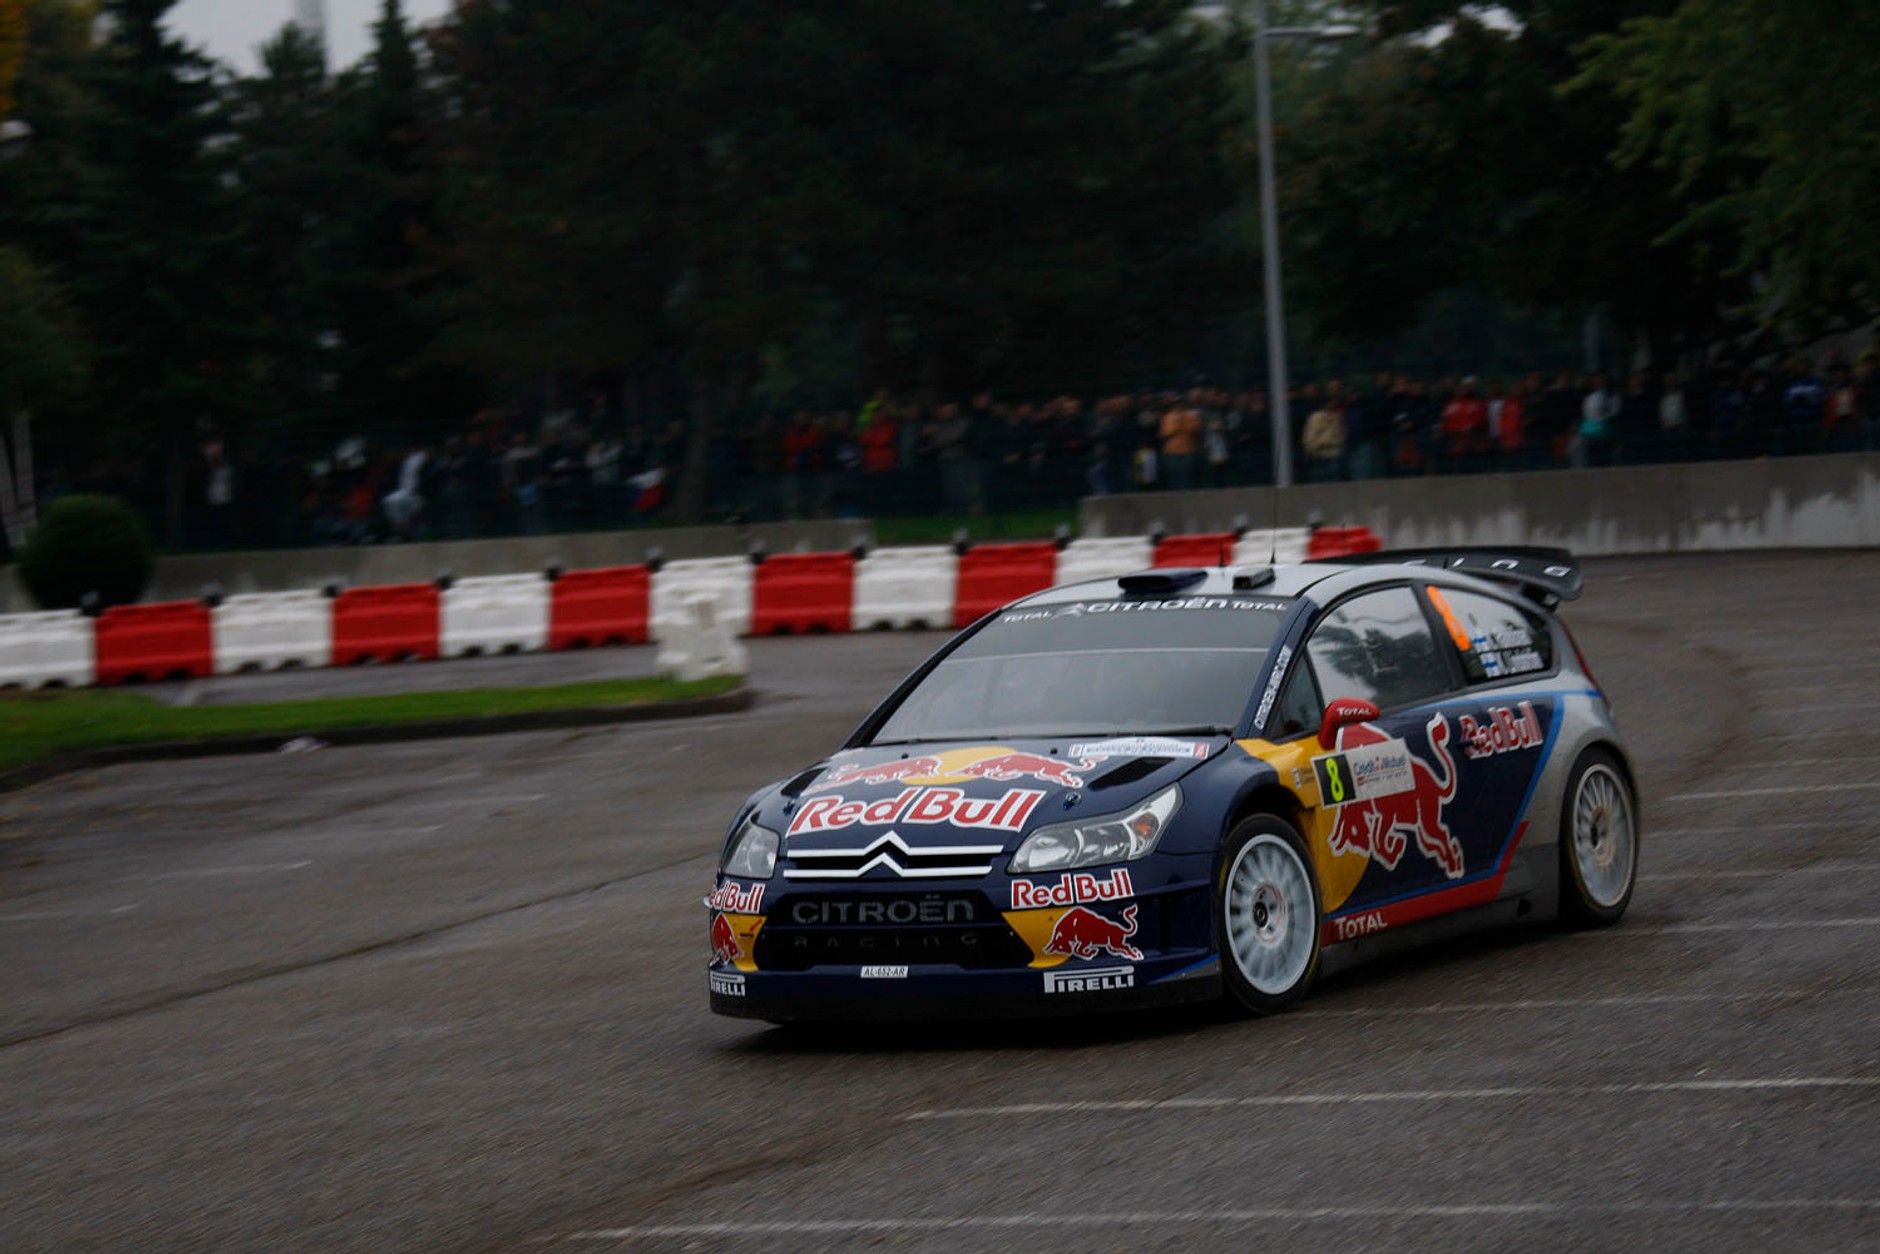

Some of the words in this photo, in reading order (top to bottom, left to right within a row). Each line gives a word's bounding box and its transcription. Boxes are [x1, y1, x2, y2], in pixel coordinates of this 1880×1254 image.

[1232, 600, 1287, 610] TOTAL
[1337, 707, 1374, 716] TOTAL
[1325, 757, 1345, 802] 8
[788, 788, 919, 835] Red
[905, 789, 1046, 831] Bull
[706, 882, 729, 910] ed
[724, 883, 764, 913] Bull
[1012, 874, 1072, 908] Red
[1074, 868, 1134, 902] Bull
[1333, 911, 1389, 940] TOTAL
[1043, 965, 1135, 994] PIRELLI
